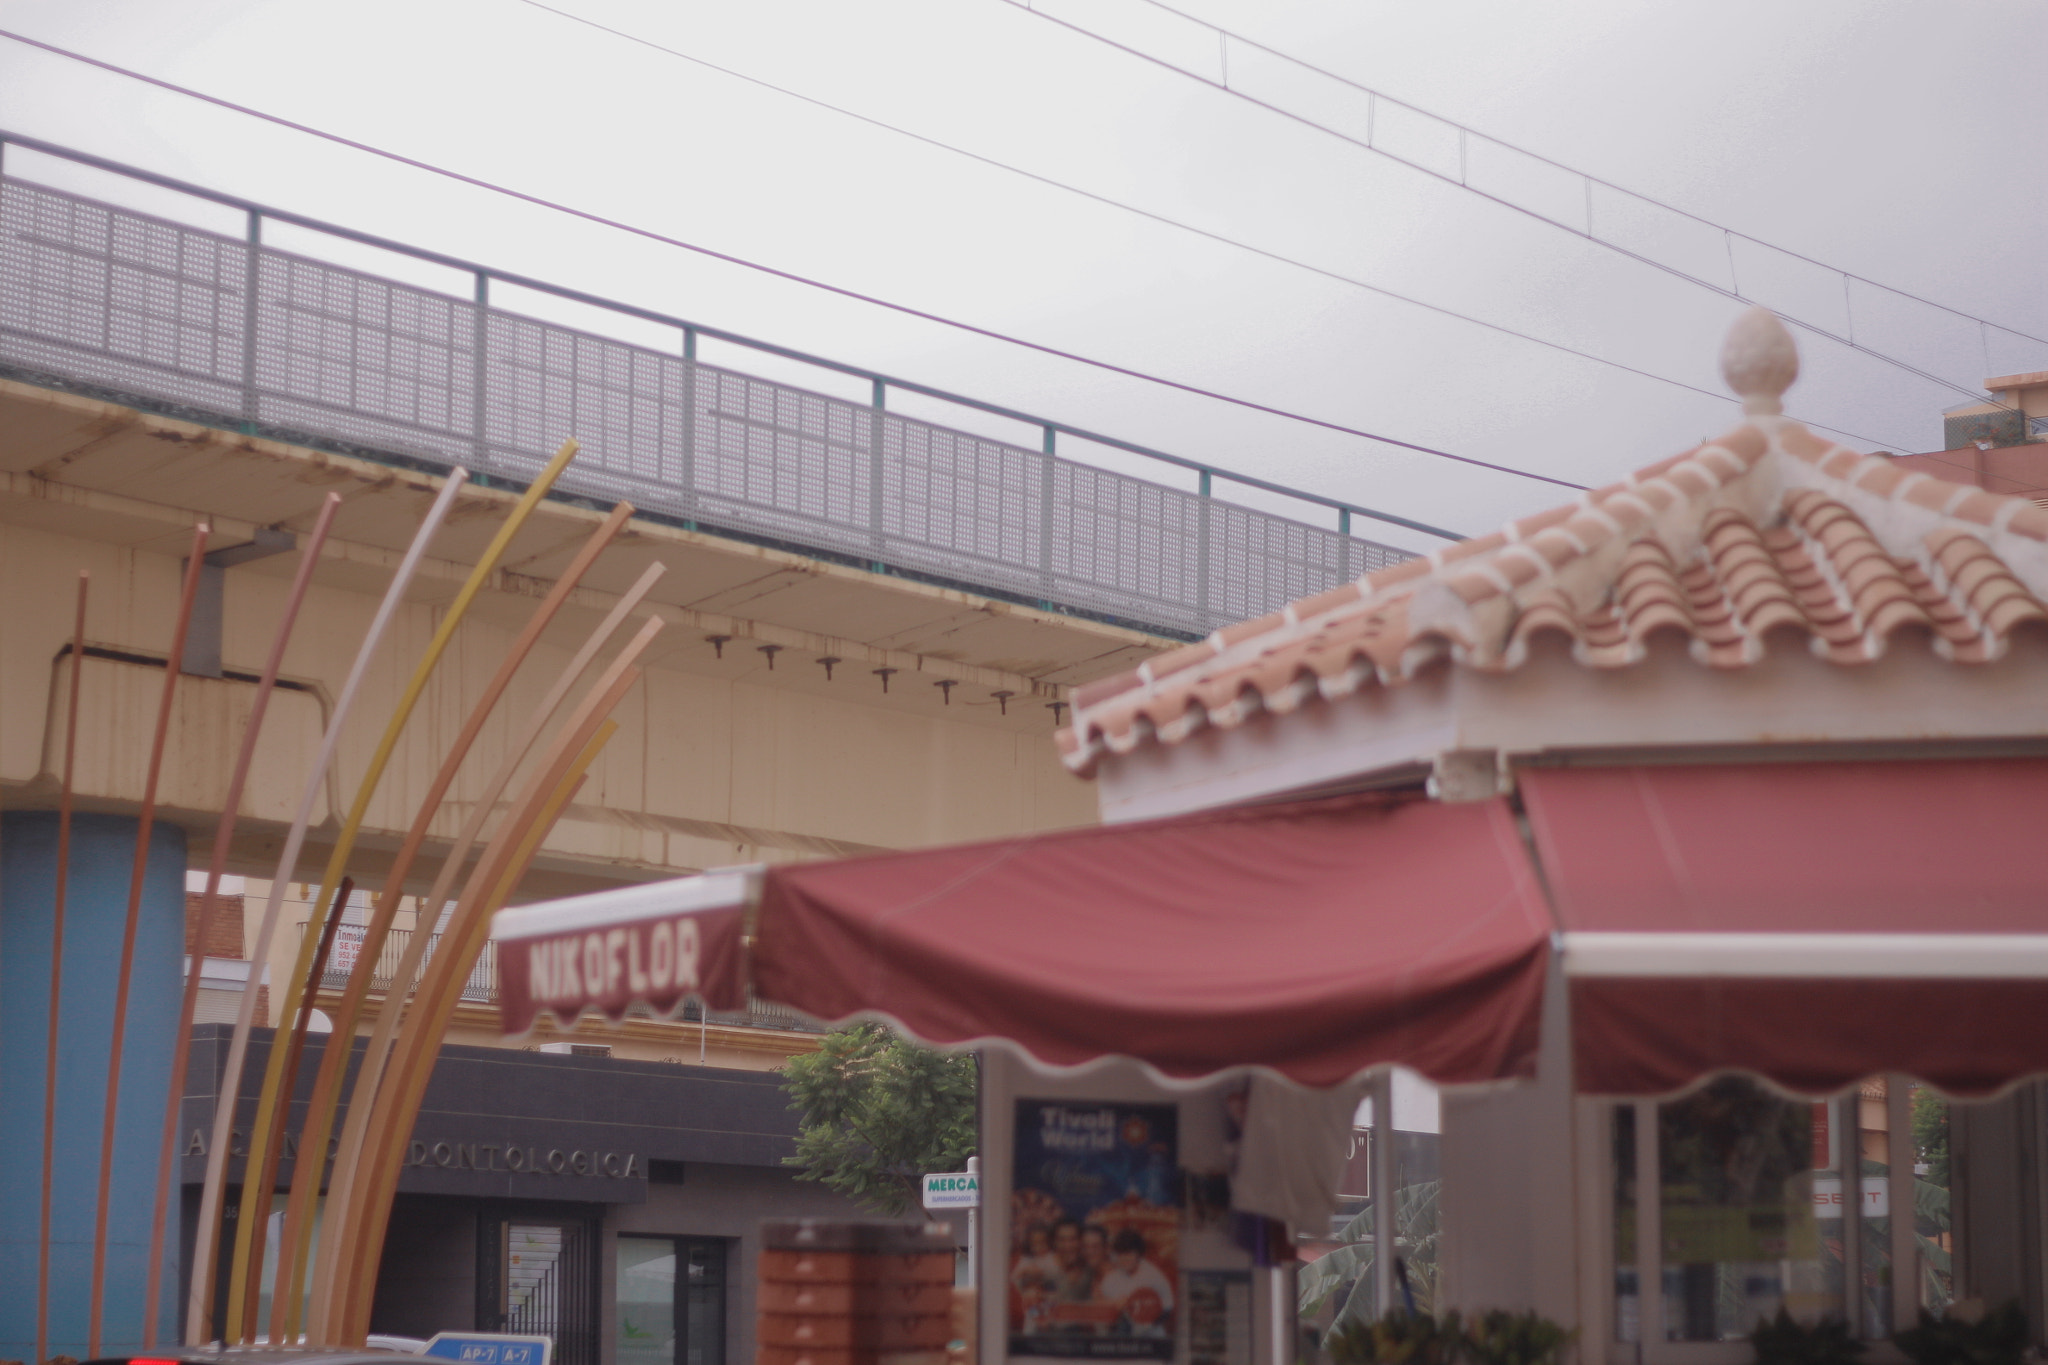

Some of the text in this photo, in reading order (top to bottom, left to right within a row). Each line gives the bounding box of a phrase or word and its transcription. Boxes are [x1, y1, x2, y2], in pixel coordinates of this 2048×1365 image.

[340, 942, 349, 950] SE
[530, 917, 699, 1001] NIKOFLOR
[1041, 1107, 1115, 1128] Tivoli
[1041, 1128, 1115, 1149] World
[928, 1178, 979, 1191] MERCA
[463, 1348, 529, 1362] AP-7 A-7
